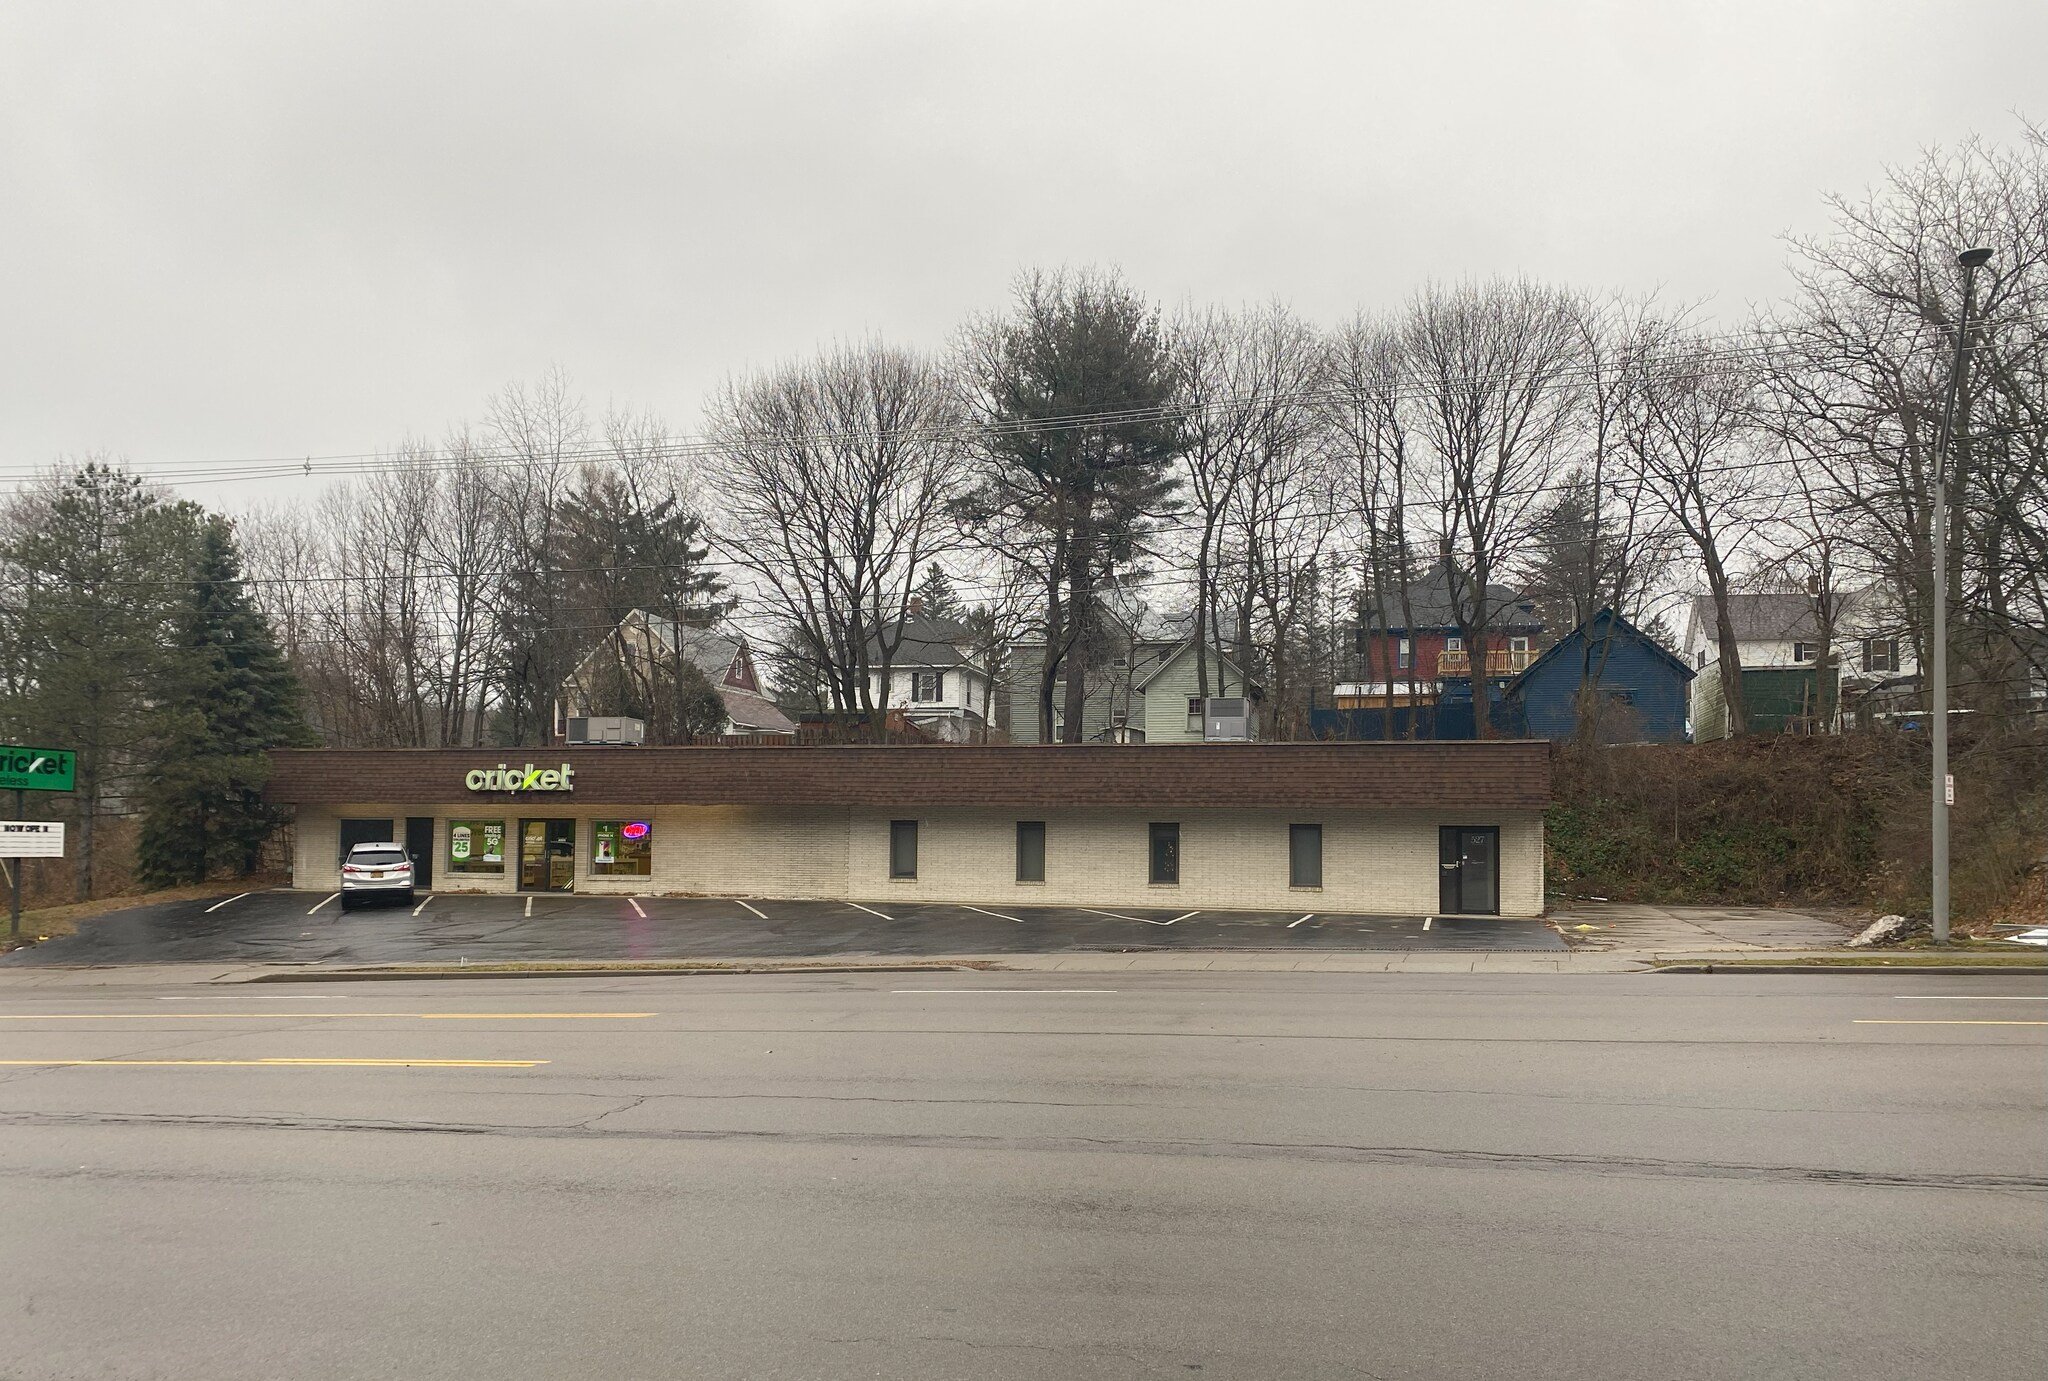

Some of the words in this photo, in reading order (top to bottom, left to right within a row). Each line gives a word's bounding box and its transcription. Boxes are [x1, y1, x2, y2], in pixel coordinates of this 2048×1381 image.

[0, 750, 67, 775] ricket
[0, 776, 29, 786] eless
[465, 763, 574, 792] cricket
[484, 825, 502, 834] FREE
[625, 826, 646, 836] OPEN
[486, 837, 499, 846] 5G
